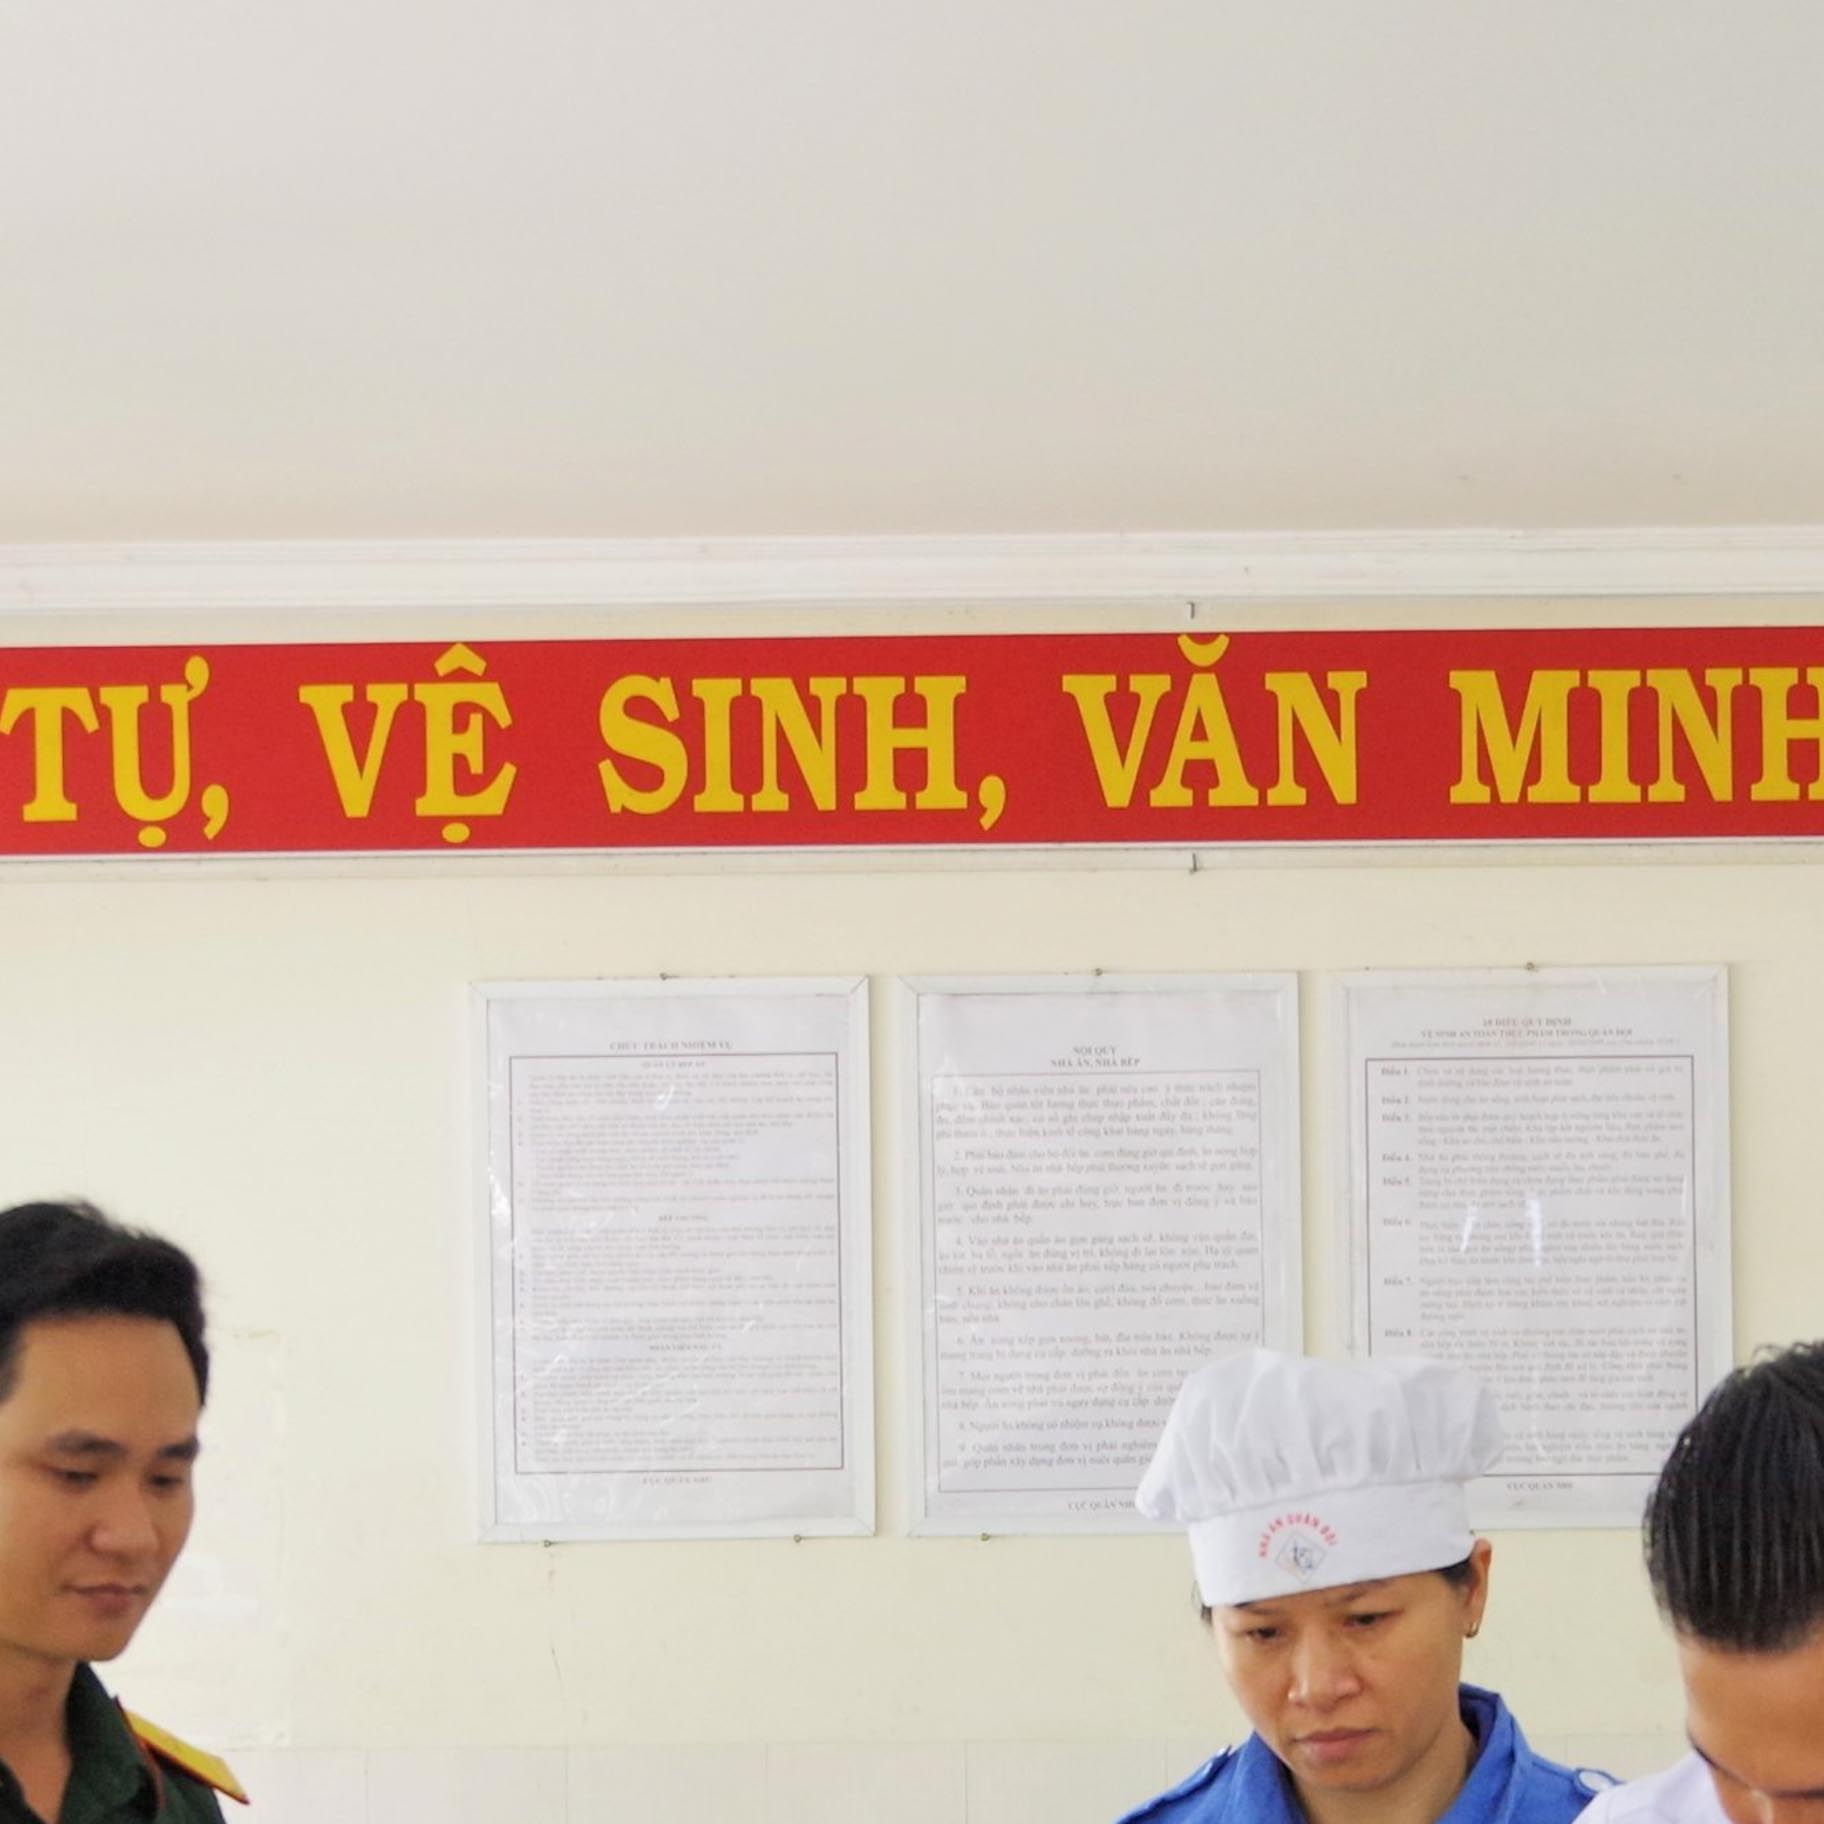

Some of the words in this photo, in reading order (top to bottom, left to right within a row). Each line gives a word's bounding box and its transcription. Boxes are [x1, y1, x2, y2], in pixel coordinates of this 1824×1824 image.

[298, 643, 516, 843] VỆ
[598, 674, 1005, 830] SINH,
[1062, 634, 1367, 807] VĂN
